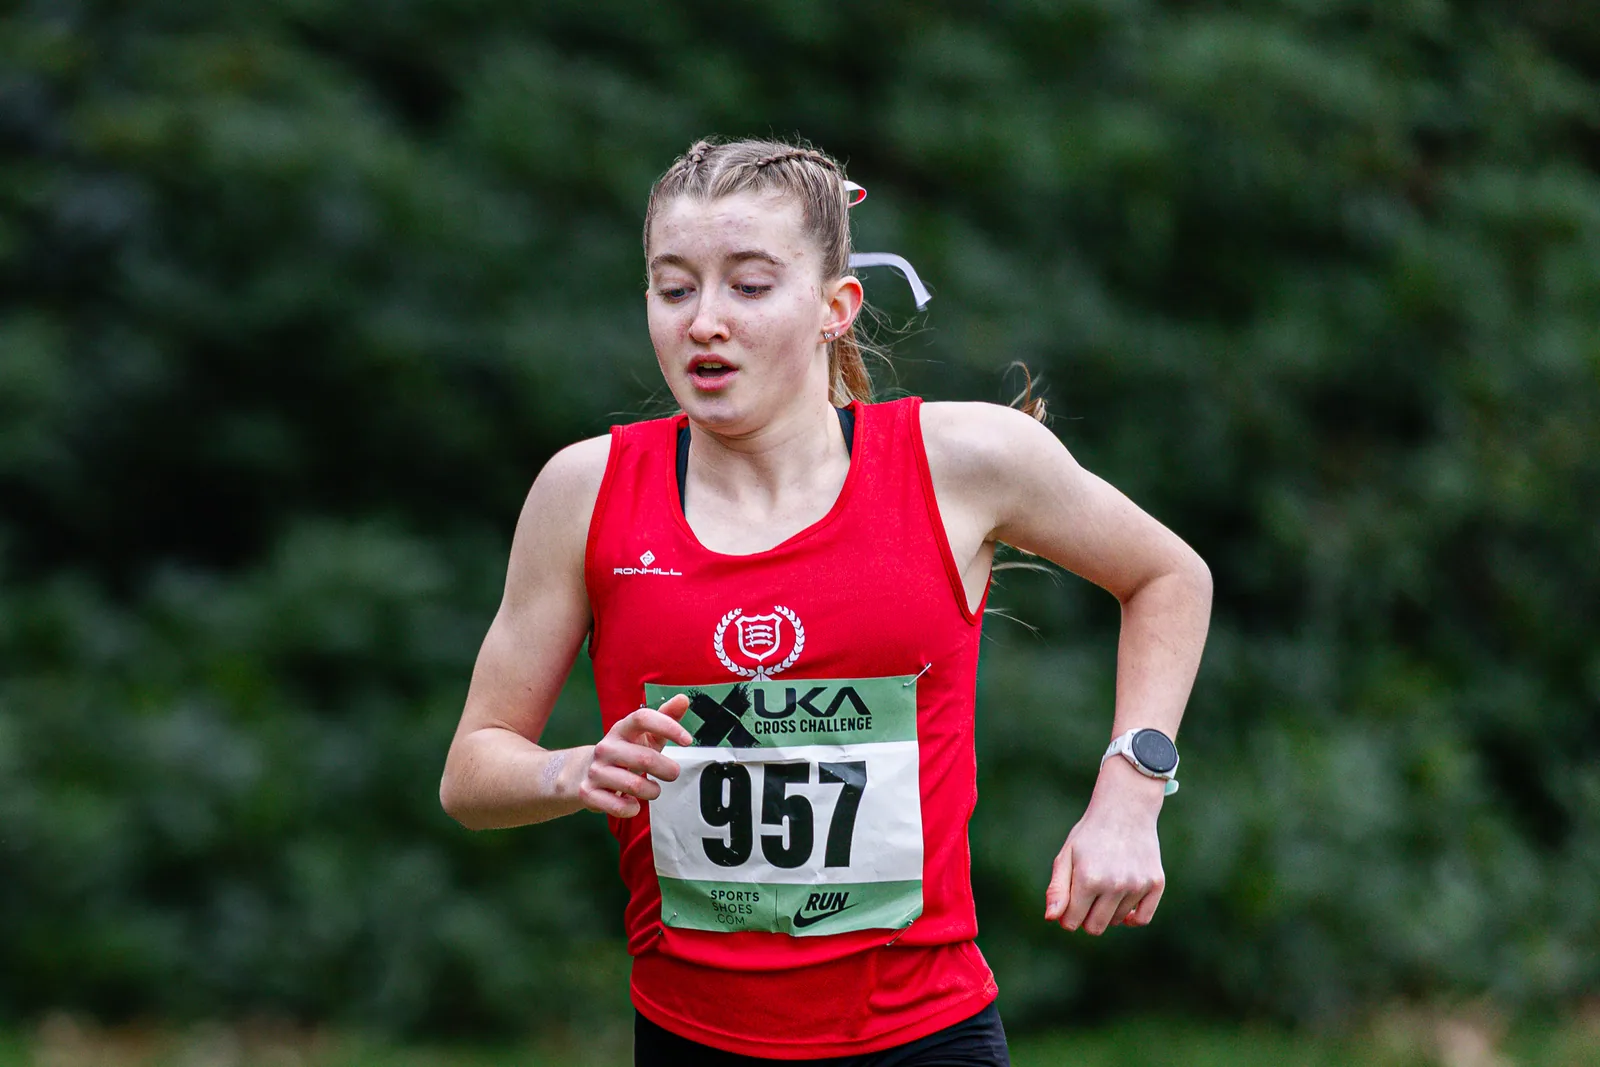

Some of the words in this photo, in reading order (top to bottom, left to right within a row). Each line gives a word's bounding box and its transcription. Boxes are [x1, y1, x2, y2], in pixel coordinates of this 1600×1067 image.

[613, 567, 683, 576] RONHILL
[753, 686, 872, 719] UKA
[754, 719, 796, 735] CROSS
[799, 716, 873, 734] CHALLENGE
[699, 760, 868, 869] 957
[710, 889, 760, 902] SPORTS
[804, 891, 850, 912] RUN
[712, 902, 753, 915] SHOES
[714, 914, 746, 926] .COM
